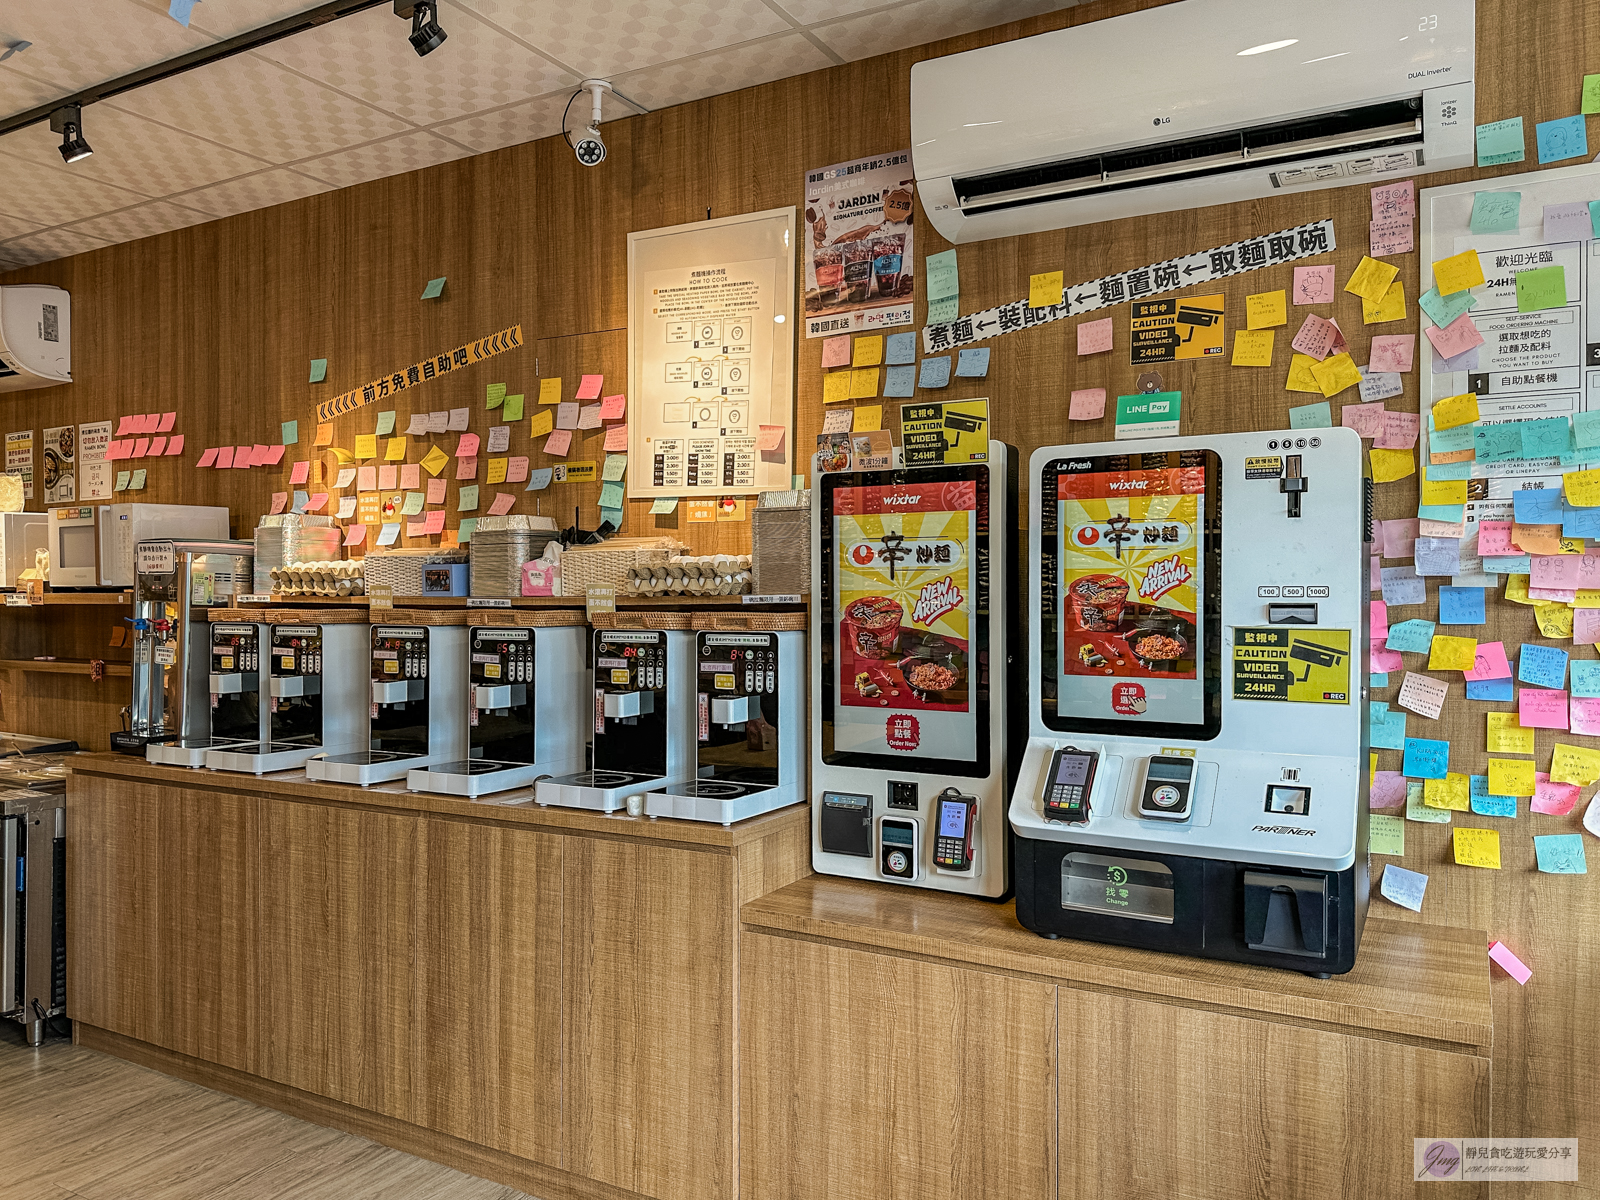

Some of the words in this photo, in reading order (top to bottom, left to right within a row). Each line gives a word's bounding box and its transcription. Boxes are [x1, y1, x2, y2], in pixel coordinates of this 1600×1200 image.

[1419, 14, 1438, 32] 23
[1408, 71, 1426, 79] DUAL
[1426, 66, 1452, 76] Inverter
[1161, 116, 1170, 124] LG
[838, 192, 880, 210] JARDIN
[833, 210, 864, 220] SIGNATURE
[1495, 250, 1553, 268] 歡迎光臨
[928, 318, 975, 350] 煮麵
[1099, 263, 1180, 301] 麵置碗
[1209, 223, 1329, 275] 取麵取碗
[1140, 304, 1167, 314] 監視中
[1132, 316, 1175, 328] CAUTION
[1506, 314, 1542, 322] SELF-SERVICE
[810, 317, 850, 334] 韓國直送
[1139, 330, 1168, 340] VIDEO
[1498, 329, 1552, 342] 選取想吃的
[1132, 338, 1172, 347] SURVEILLANCE
[1498, 341, 1552, 354] 拉麵及配料
[1140, 348, 1166, 357] 24HR
[362, 347, 468, 404] 前方免費自助吧
[1501, 373, 1558, 386] 自助點餐機
[1476, 380, 1482, 388] 1
[910, 408, 934, 418] 監視中
[1126, 405, 1148, 414] LINE
[904, 422, 942, 432] CAUTION
[910, 434, 937, 443] VIDEO
[912, 452, 936, 460] 24HR
[1057, 462, 1068, 470] La
[1069, 461, 1092, 470] Fresh
[1109, 480, 1149, 490] wixtar
[1475, 484, 1482, 492] 2
[883, 494, 922, 505] wixtar
[1104, 514, 1139, 559] 辛
[1143, 526, 1179, 543] 炒麵
[878, 530, 912, 581] 辛
[916, 544, 951, 564] 炒麵
[1150, 556, 1180, 577] NEW
[1140, 565, 1190, 596] ARRIVAL
[922, 577, 950, 600] NEW
[913, 588, 961, 620] ARRIVAL
[1244, 632, 1278, 643] 監視中
[730, 649, 744, 660] 84
[1236, 649, 1287, 658] CAUTION
[1243, 663, 1279, 672] VIDEO
[1120, 687, 1137, 695] 立即
[1244, 683, 1276, 692] 24HR
[894, 719, 911, 728] 立即
[1106, 887, 1128, 898] 找零
[1106, 898, 1128, 906] Change
